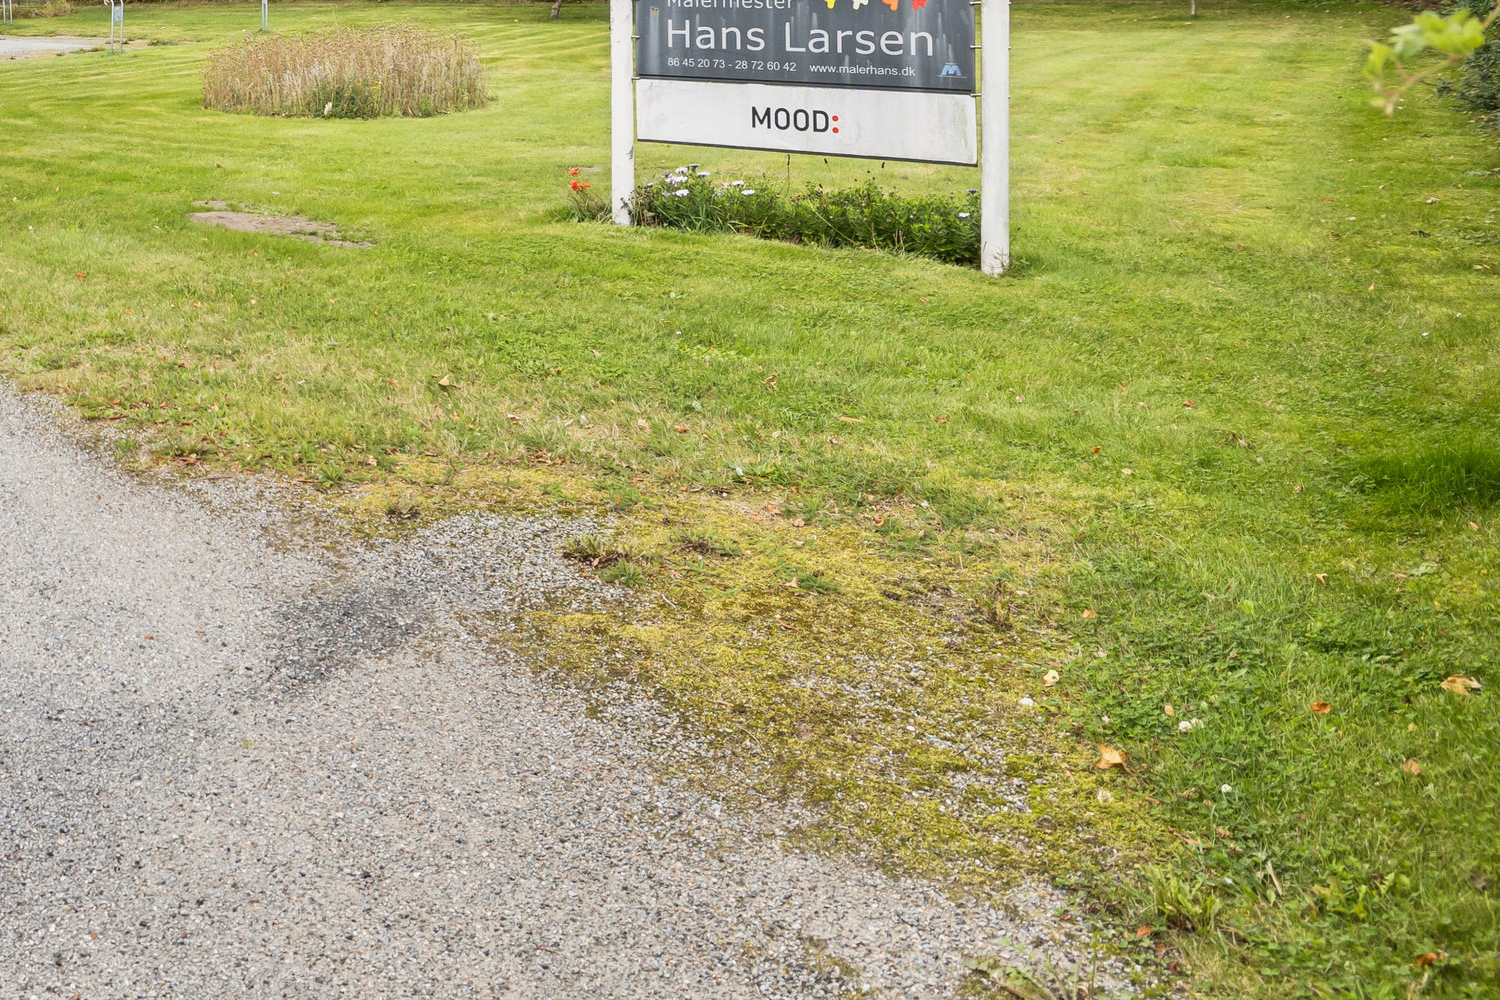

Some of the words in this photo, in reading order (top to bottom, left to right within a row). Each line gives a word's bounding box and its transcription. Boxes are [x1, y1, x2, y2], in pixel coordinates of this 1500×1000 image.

[667, 19, 766, 51] Hans
[785, 21, 933, 57] Larsen
[667, 57, 680, 67] 86
[682, 58, 695, 68] 45
[697, 58, 710, 68] 20
[713, 59, 726, 69] 73
[735, 60, 748, 70] 28
[751, 61, 764, 71] 72
[767, 61, 780, 71] 60
[783, 62, 797, 72] 42
[809, 64, 916, 77] www.malerhans.dk
[751, 105, 840, 134] MOOD:
